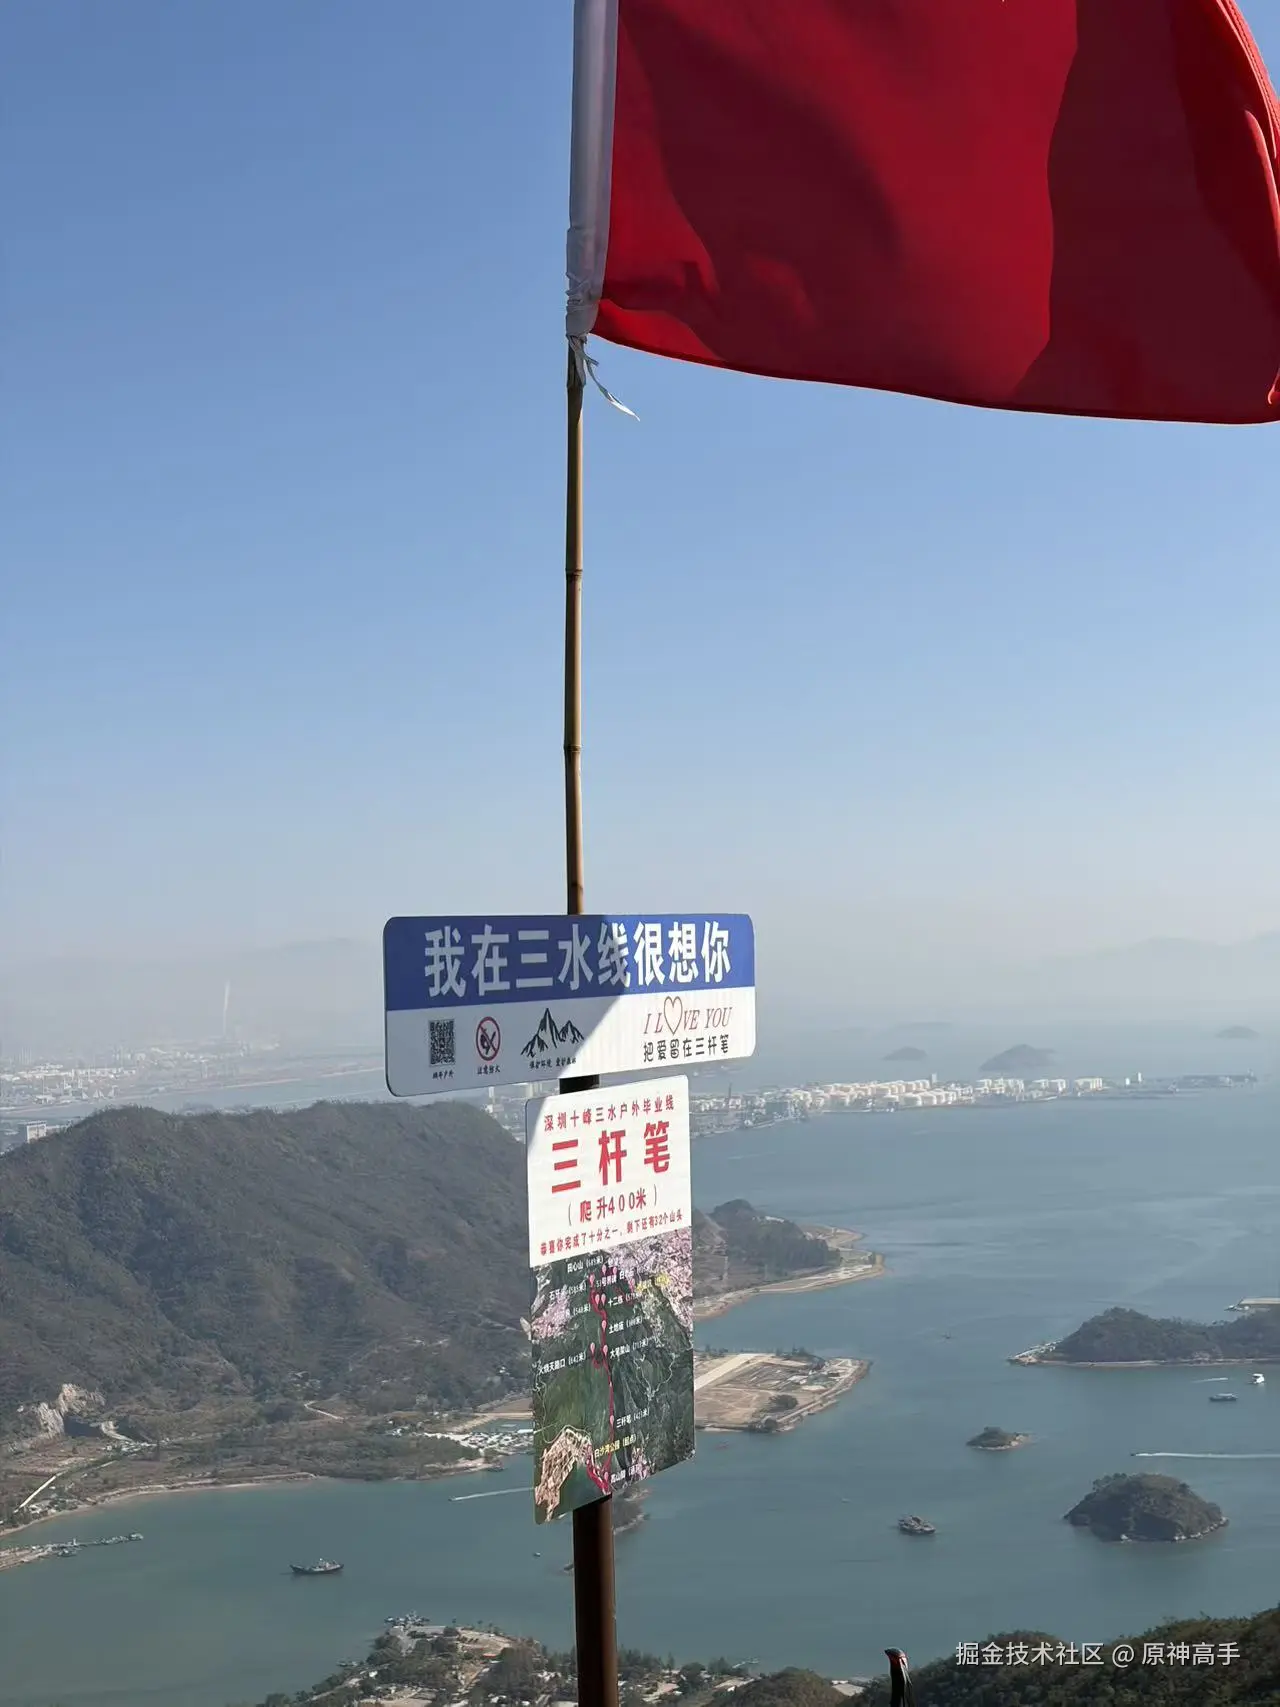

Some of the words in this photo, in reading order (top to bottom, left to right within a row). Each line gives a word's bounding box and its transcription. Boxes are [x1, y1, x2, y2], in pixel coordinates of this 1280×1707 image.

[425, 921, 731, 998] 我在三水线很想你
[643, 1013, 651, 1034] I
[704, 1006, 733, 1029] YOU
[643, 1034, 729, 1062] 把爱留在三杆笔
[544, 1094, 675, 1131] 深圳十峰三水户外毕业线
[552, 1120, 671, 1194] 三杆笔
